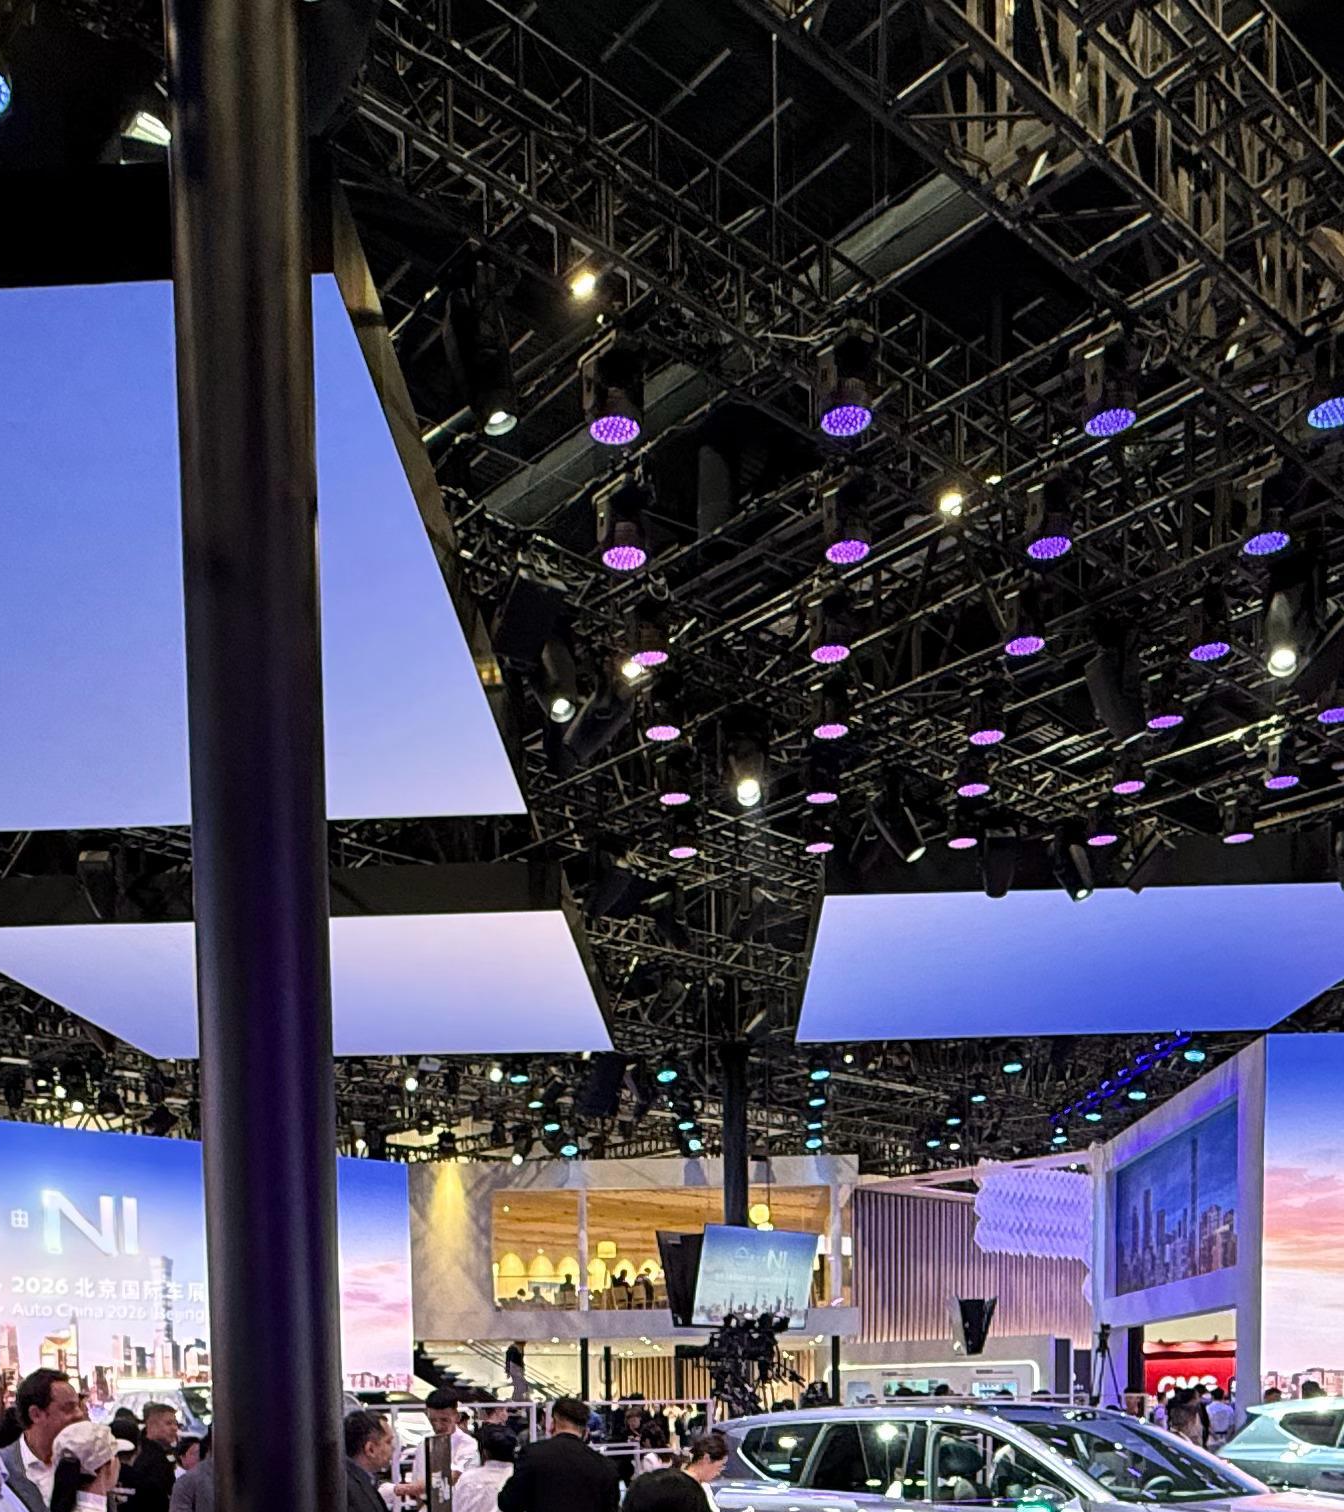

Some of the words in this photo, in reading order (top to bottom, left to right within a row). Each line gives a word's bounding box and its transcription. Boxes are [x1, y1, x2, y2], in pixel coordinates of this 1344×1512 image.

[11, 1276, 69, 1295] 2026
[12, 1304, 52, 1317] Auto
[55, 1303, 104, 1319] China
[108, 1305, 146, 1319] 2026
